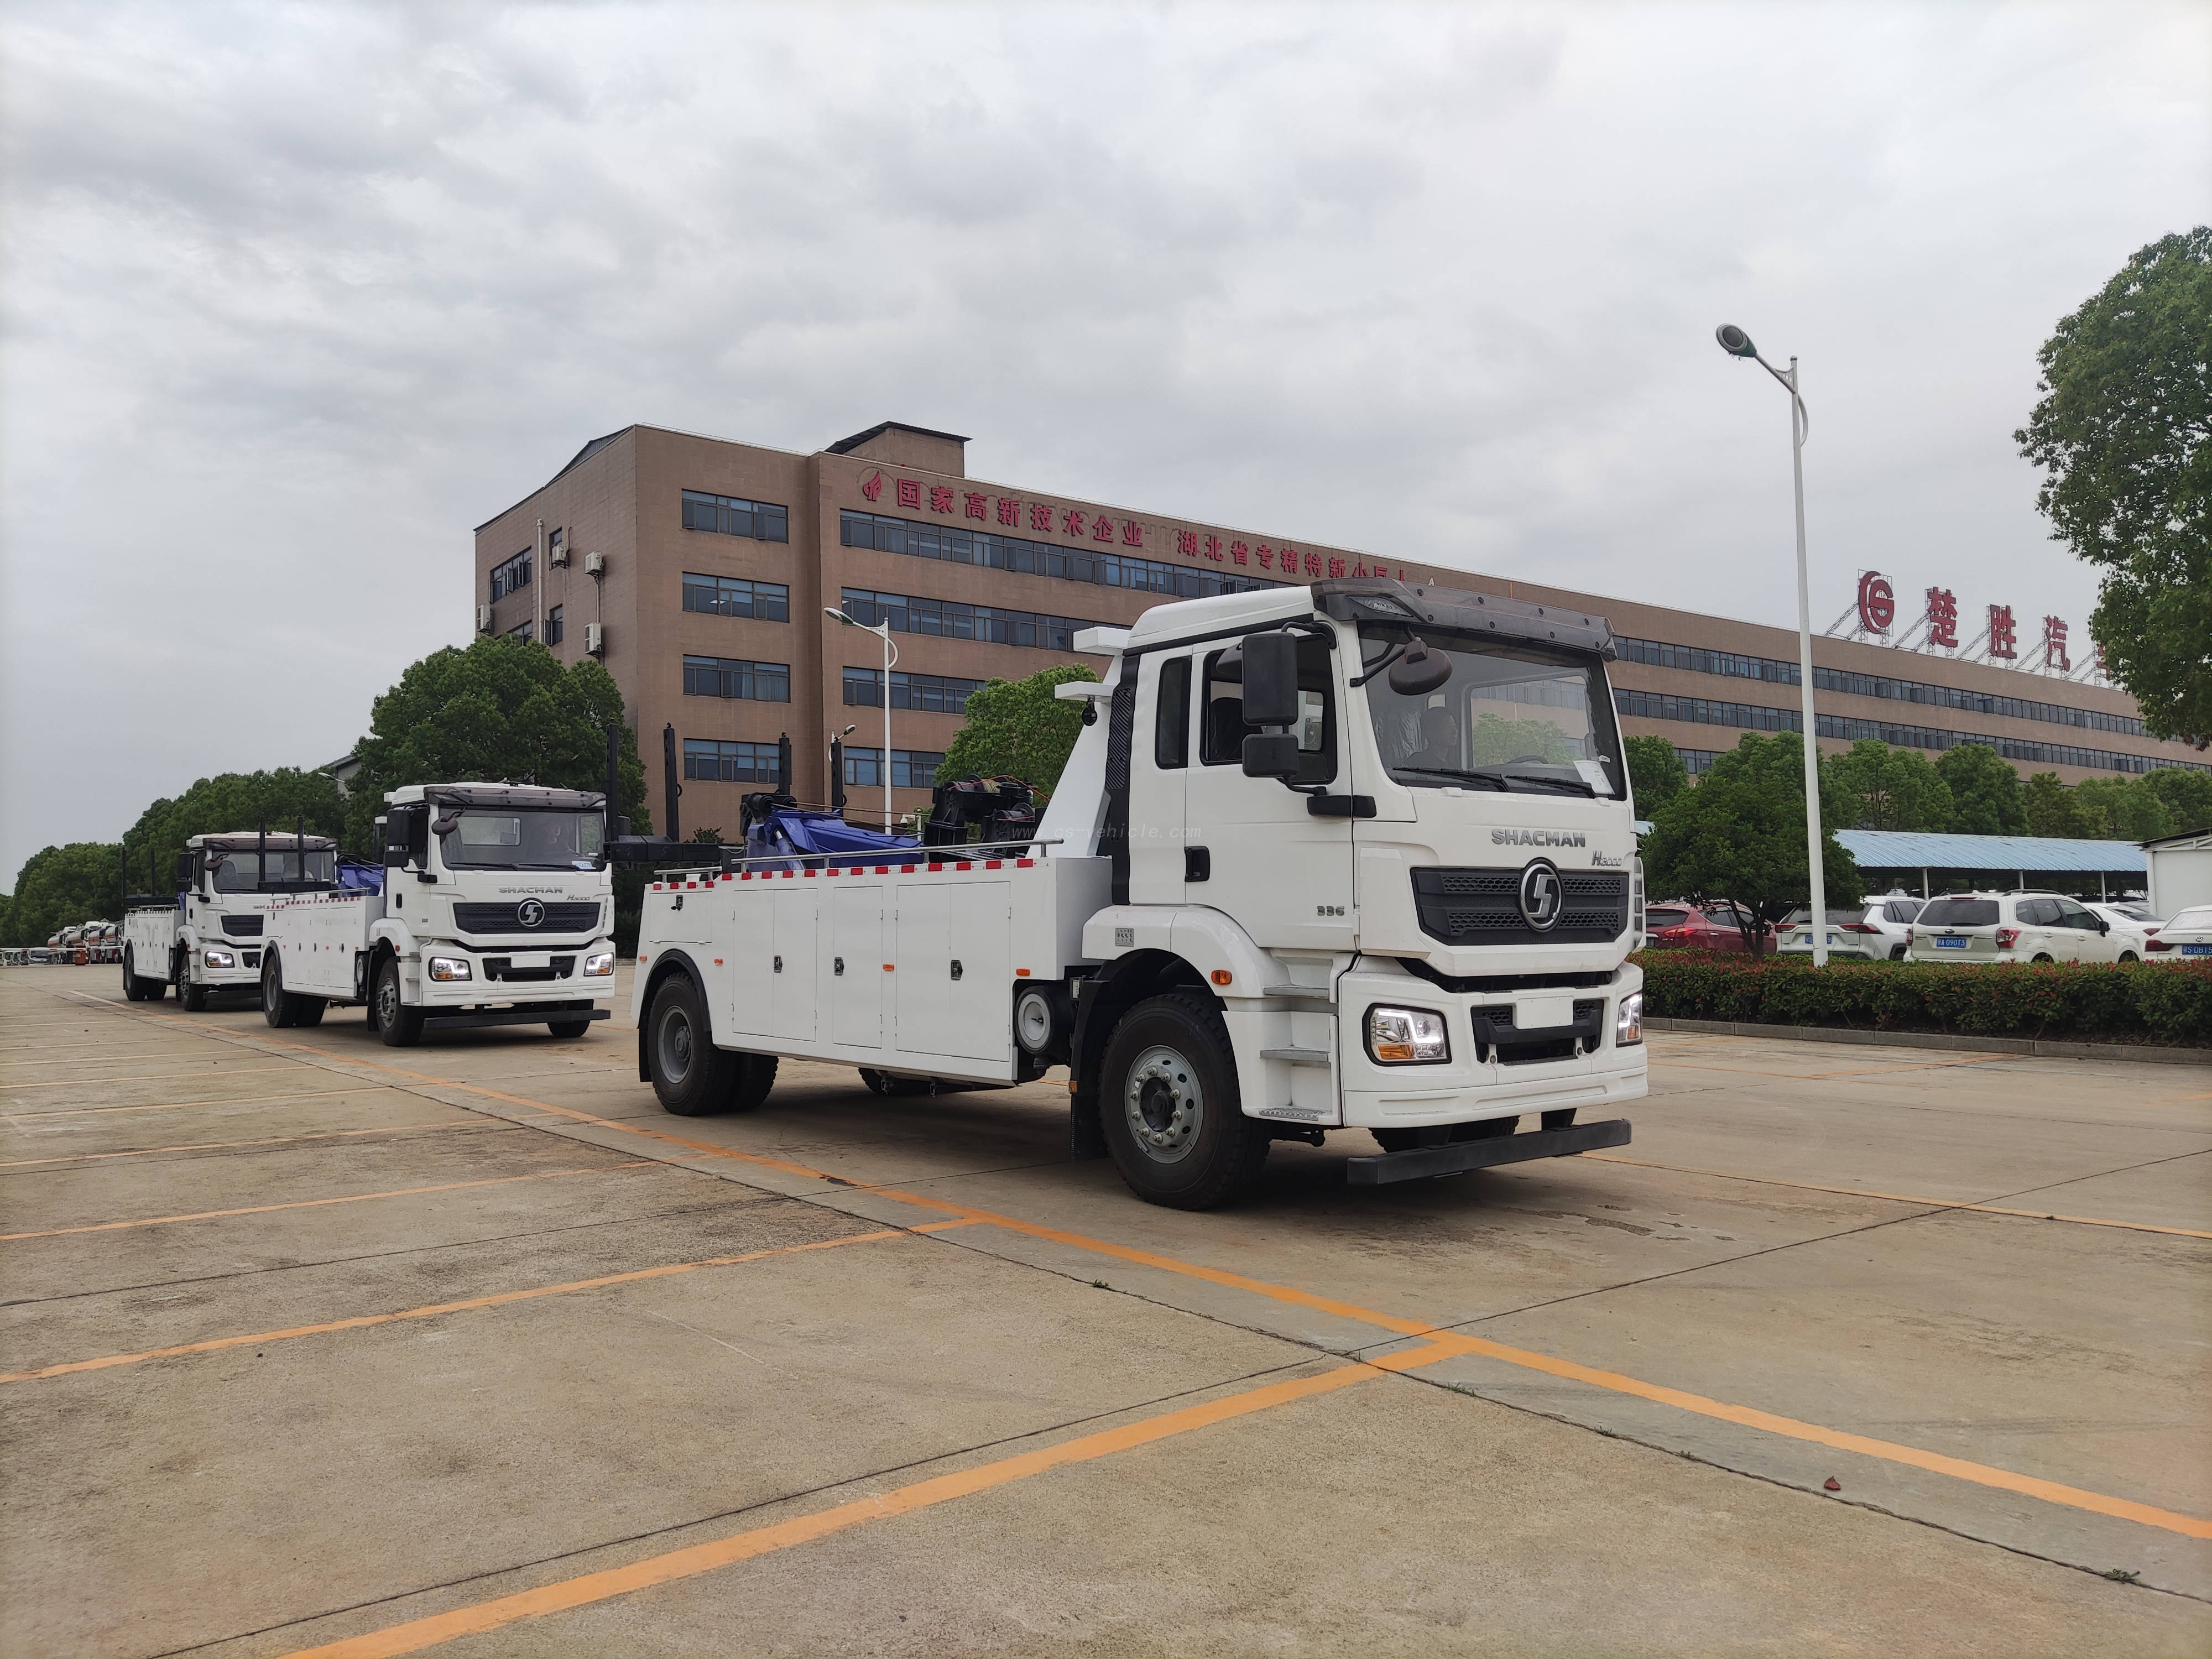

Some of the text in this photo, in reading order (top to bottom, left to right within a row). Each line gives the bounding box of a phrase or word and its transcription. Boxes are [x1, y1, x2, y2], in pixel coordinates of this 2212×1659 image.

[898, 478, 1143, 547] 国家高新技术企业
[1928, 586, 2112, 681] 楚胜汽
[1491, 829, 1586, 847] SHACMAN
